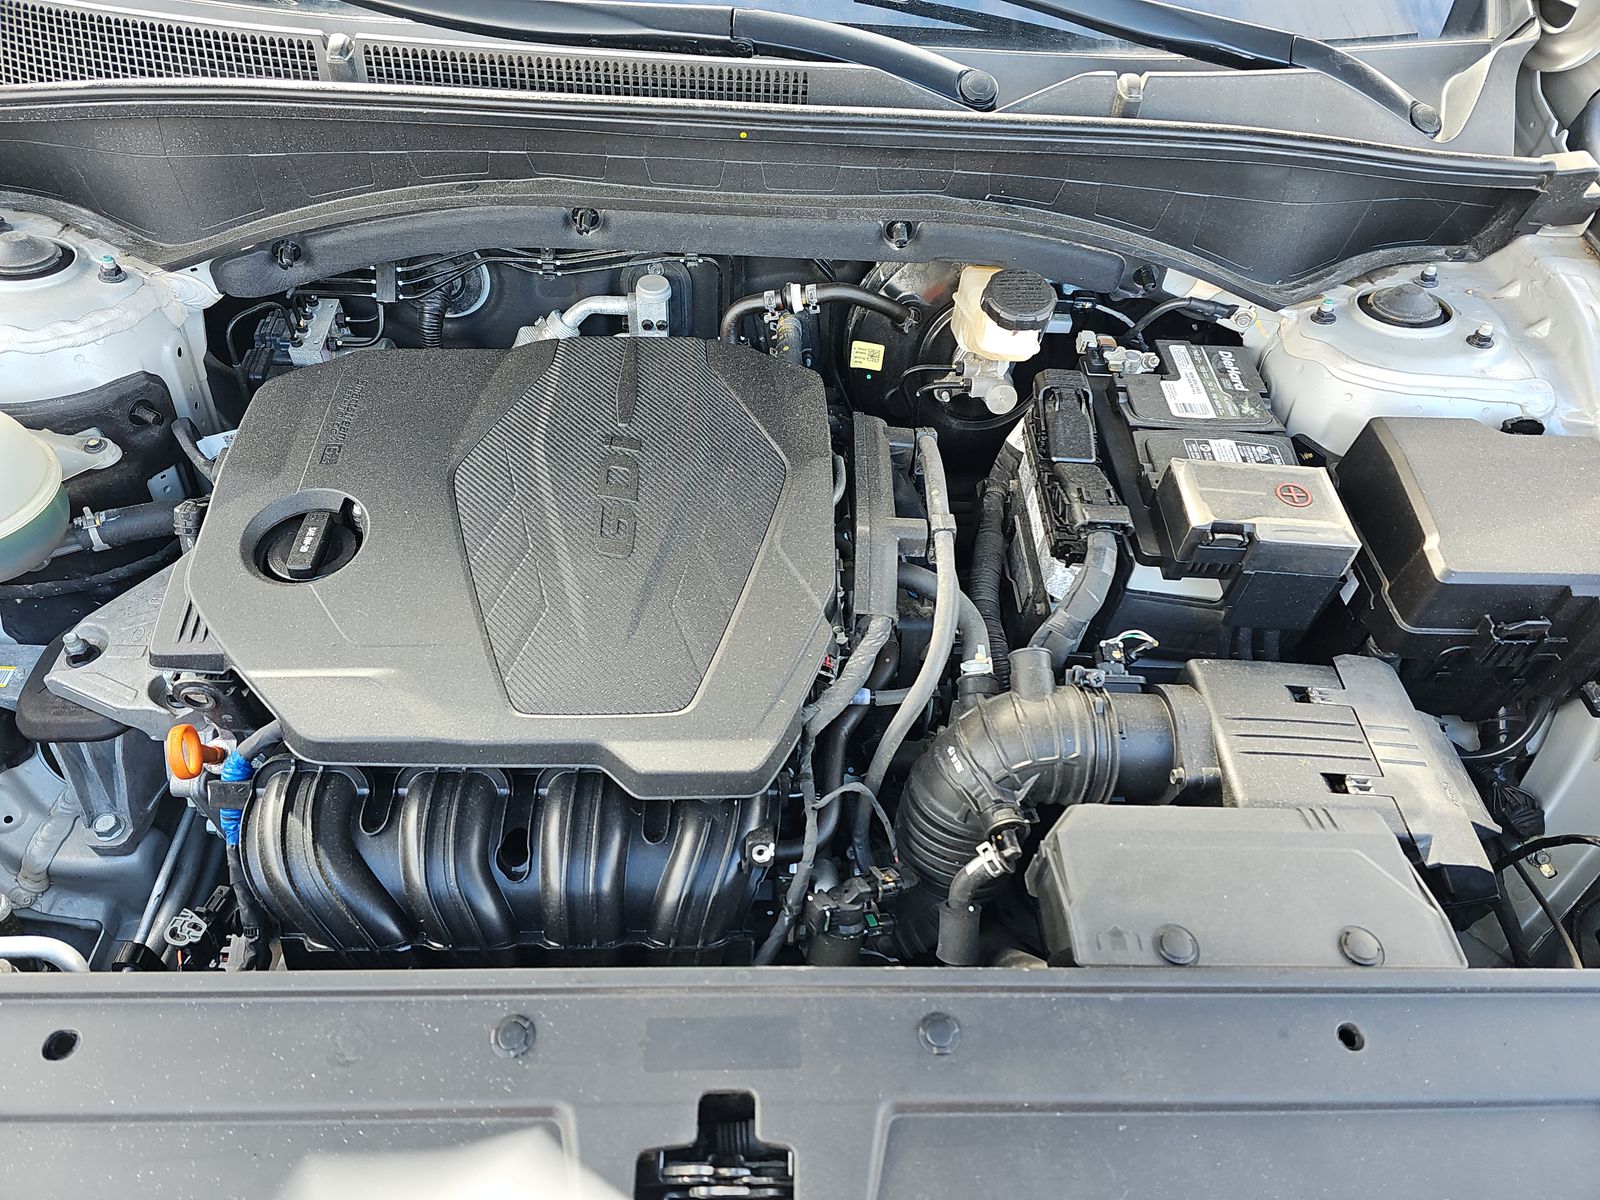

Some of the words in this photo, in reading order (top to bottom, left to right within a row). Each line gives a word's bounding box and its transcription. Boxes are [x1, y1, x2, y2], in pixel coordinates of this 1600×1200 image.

[1218, 350, 1250, 392] DieHard
[338, 379, 369, 441] Smartstream
[593, 435, 641, 556] GDI
